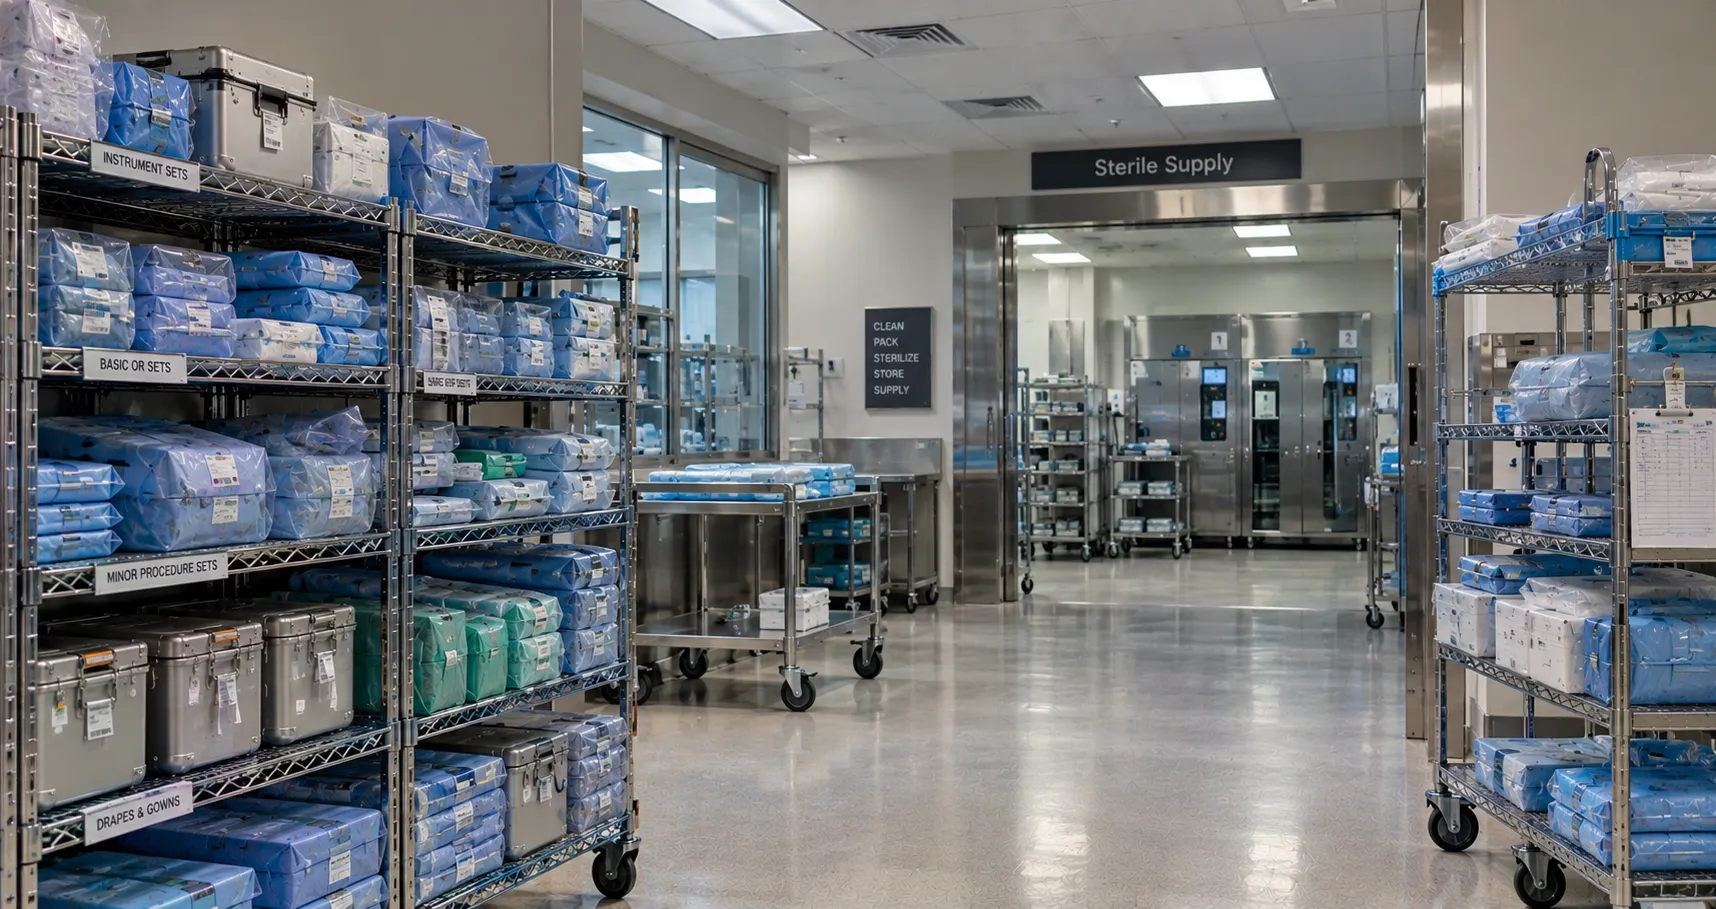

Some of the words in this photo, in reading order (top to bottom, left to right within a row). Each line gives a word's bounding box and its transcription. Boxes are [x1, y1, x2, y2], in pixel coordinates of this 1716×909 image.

[103, 151, 163, 175] INSTRUMENT
[165, 165, 188, 180] SETS
[1095, 156, 1158, 177] Sterile
[1164, 153, 1234, 177] Supply
[873, 321, 905, 331] CLEAN
[873, 337, 899, 347] PACK
[873, 353, 920, 363] STERILIZE
[100, 358, 129, 371] BASIC
[131, 359, 145, 372] OR
[147, 360, 172, 374] SETS
[873, 369, 905, 379] STORE
[873, 385, 910, 395] SUPPLY
[107, 568, 138, 583] MINOR
[140, 562, 194, 579] PROCEDURE
[196, 559, 218, 573] SETS
[97, 809, 135, 831] DRAPES
[137, 806, 144, 819] &
[146, 795, 180, 815] GOWNS
